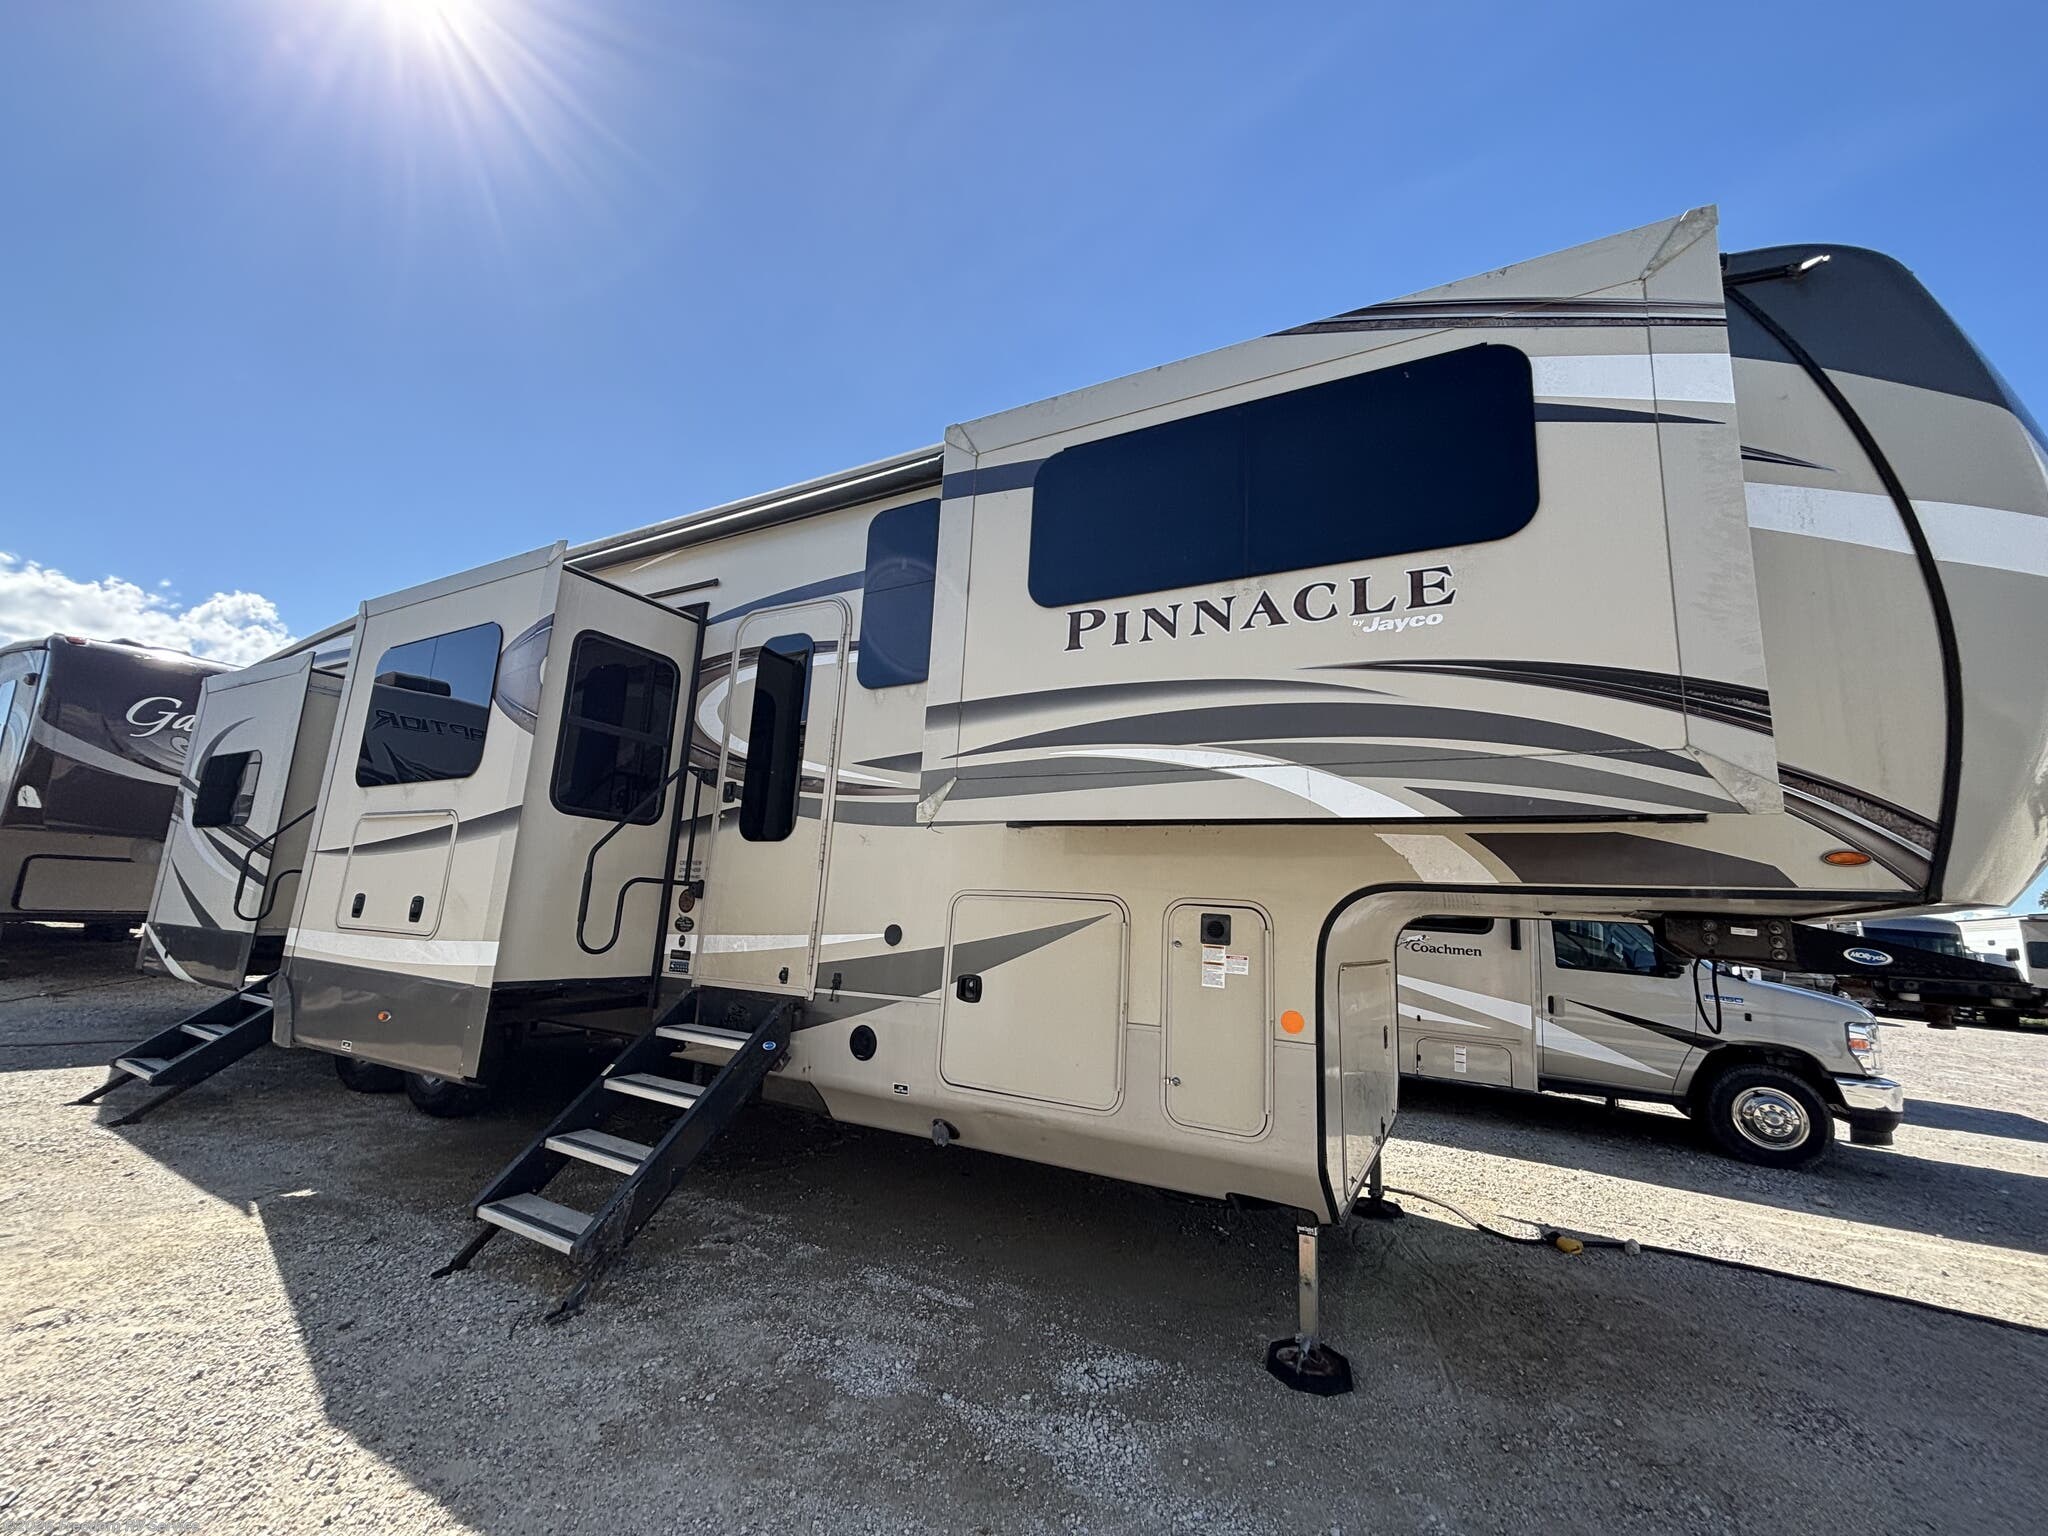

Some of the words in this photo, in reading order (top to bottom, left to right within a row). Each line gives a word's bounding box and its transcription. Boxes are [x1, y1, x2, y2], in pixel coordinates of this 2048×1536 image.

[1062, 564, 1458, 652] PINNACLE
[1352, 618, 1364, 627] by
[1362, 613, 1444, 633] Jayco
[1411, 942, 1482, 957] Coachmen
